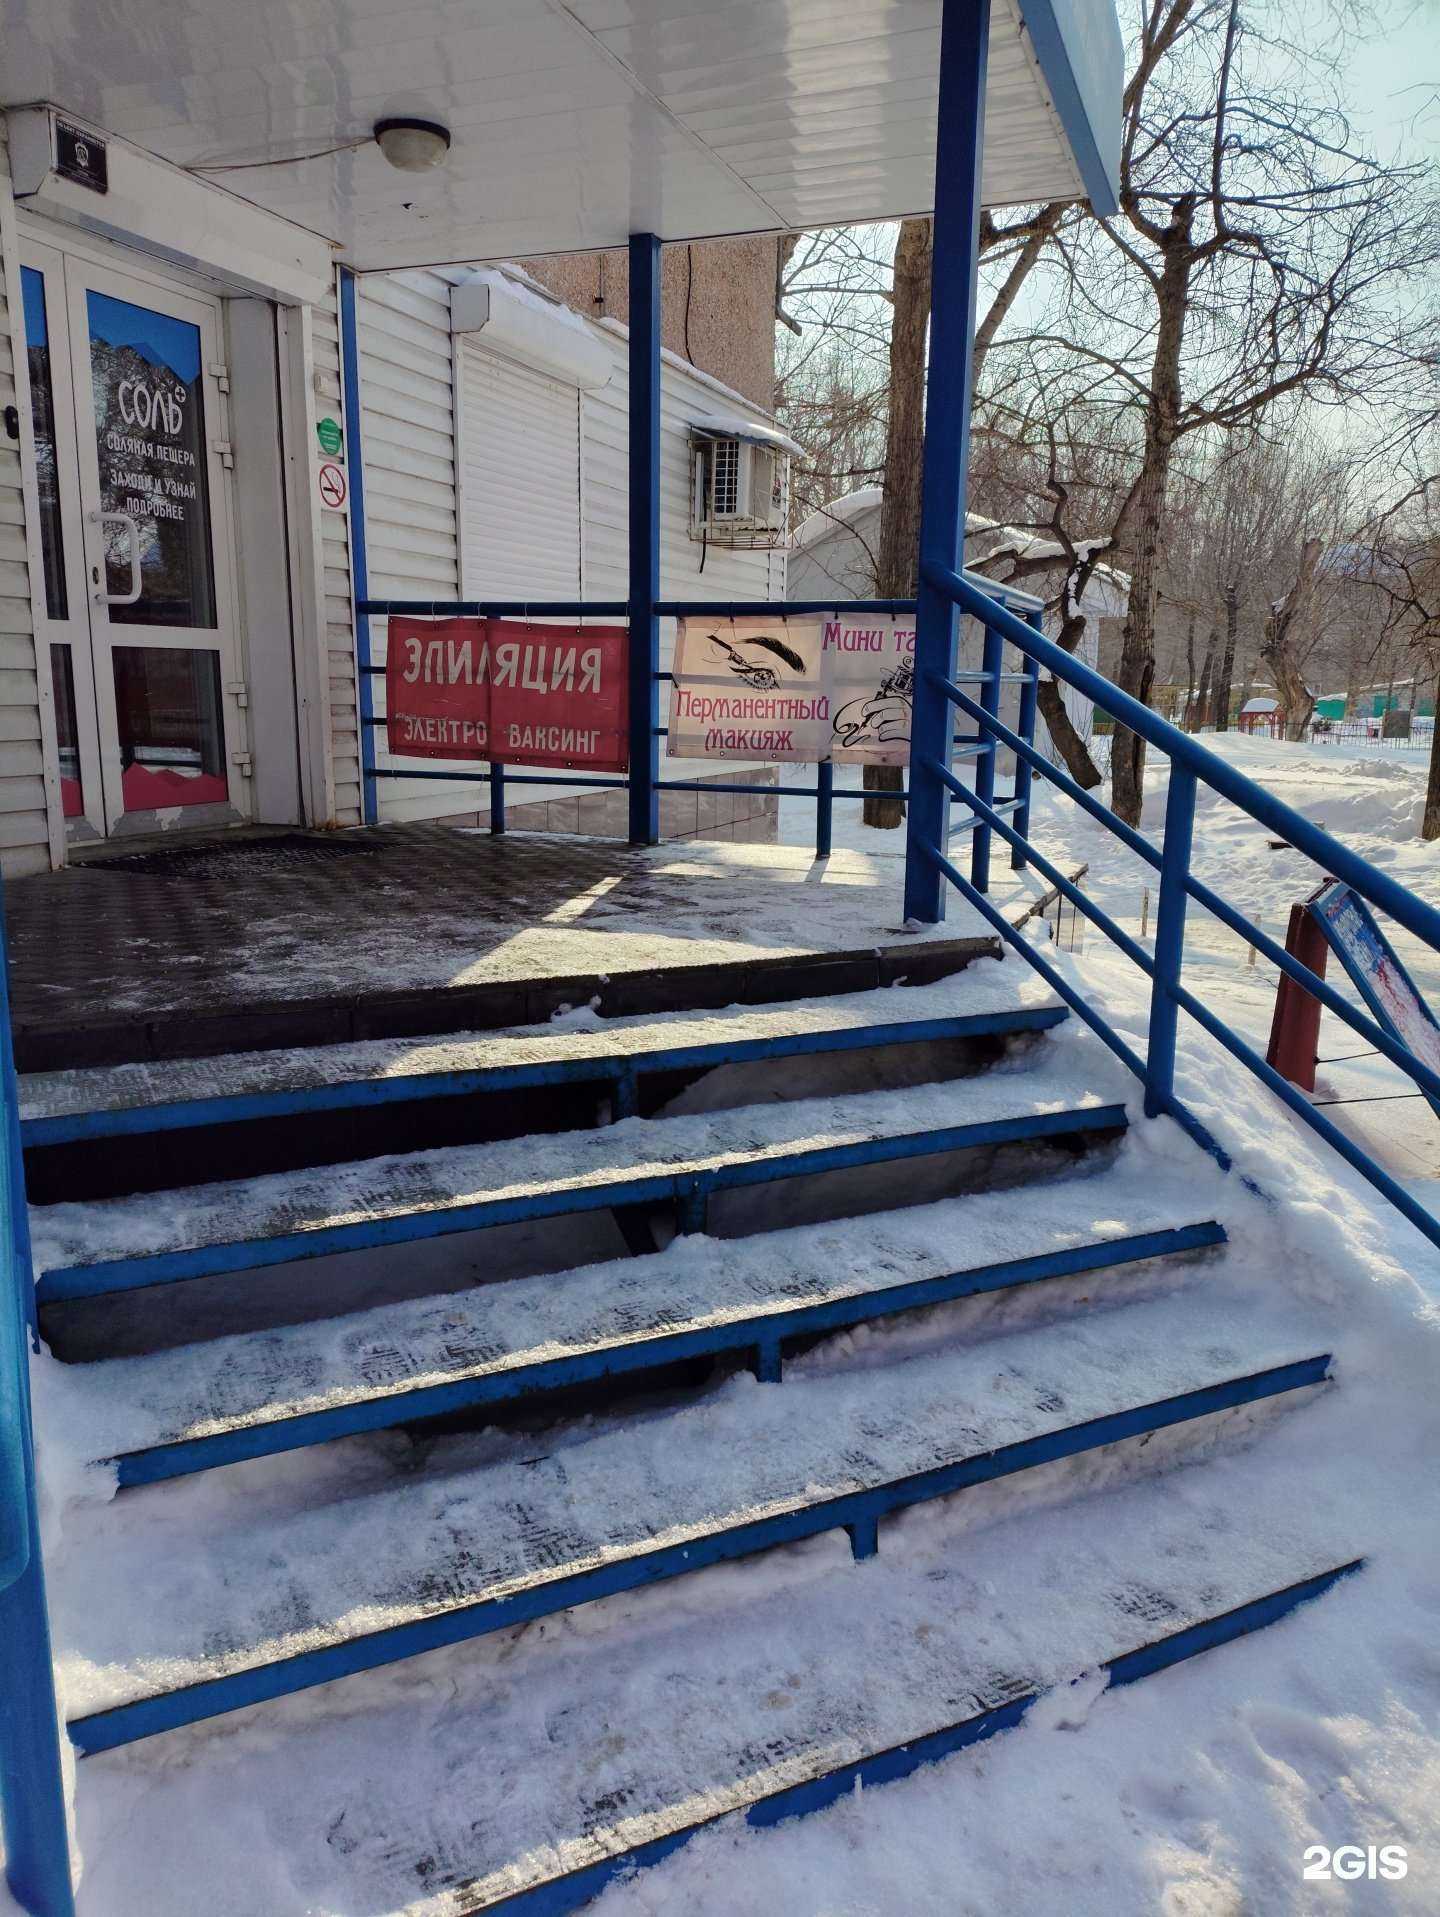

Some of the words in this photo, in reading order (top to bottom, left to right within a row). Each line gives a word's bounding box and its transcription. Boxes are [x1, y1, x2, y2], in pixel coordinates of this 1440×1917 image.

[118, 380, 183, 434] СОЛЬ
[106, 431, 154, 458] СОЛЯНАЯ
[156, 445, 195, 466] ПЕЩЕРА
[110, 468, 152, 491] ЗАХОДИ
[154, 478, 163, 495] И
[164, 478, 197, 500] УЗНАЙ
[126, 497, 185, 521] ПОДРОБНЕЕ
[822, 622, 883, 652] Мини
[402, 637, 601, 694] ЭПИЛЯЦИЯ
[675, 690, 830, 724] Перманентный
[403, 717, 488, 745] ЭЛЕКТРО
[509, 723, 601, 754] ВАКСИНГ
[704, 727, 795, 751] макияж
